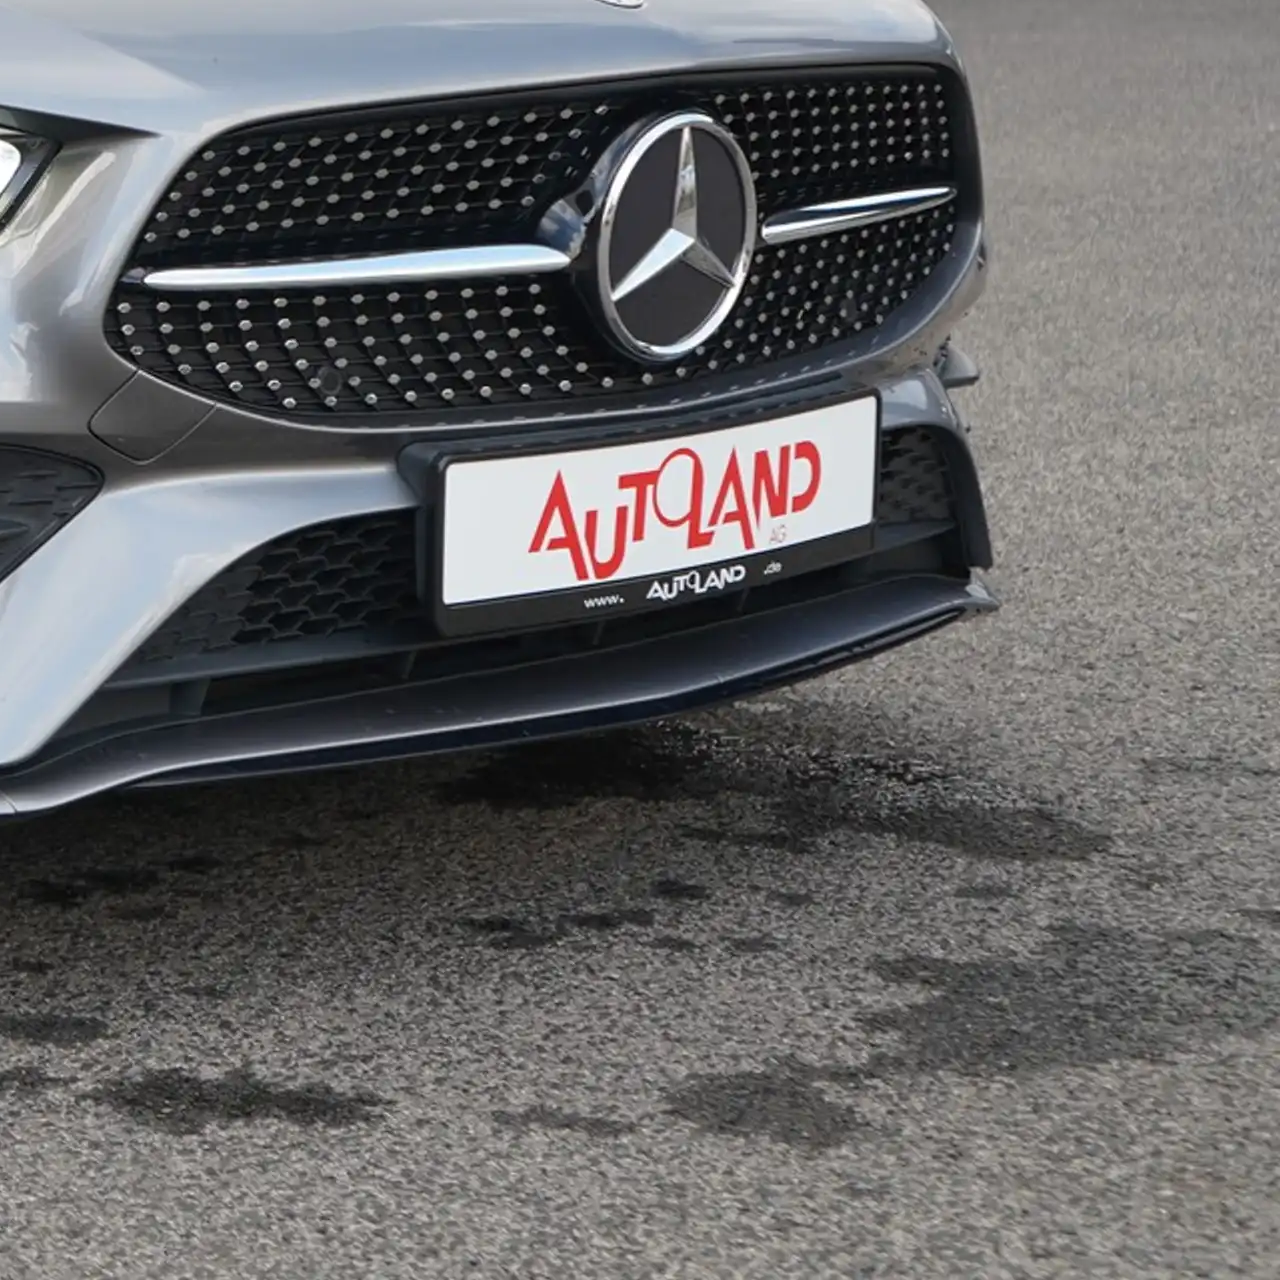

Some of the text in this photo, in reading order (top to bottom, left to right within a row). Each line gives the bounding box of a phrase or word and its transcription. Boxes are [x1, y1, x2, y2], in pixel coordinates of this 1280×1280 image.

[528, 439, 822, 582] AUTOLAND
[583, 594, 625, 609] www.
[646, 565, 746, 601] AUTOLAND
